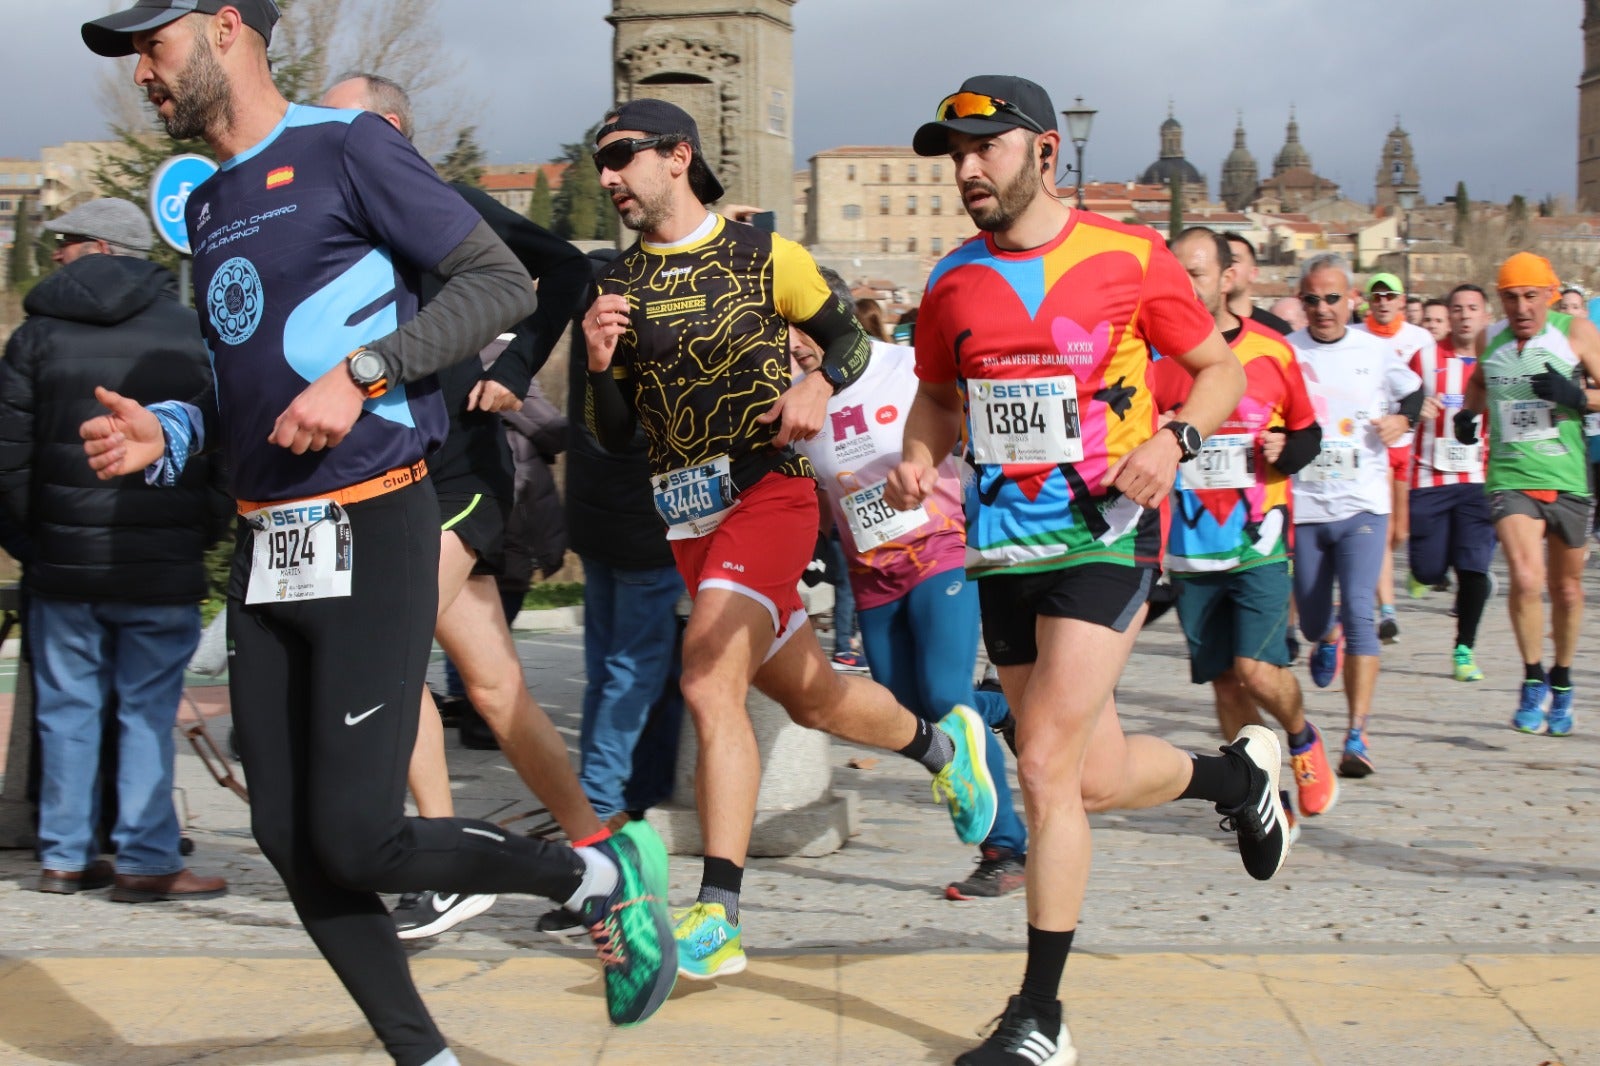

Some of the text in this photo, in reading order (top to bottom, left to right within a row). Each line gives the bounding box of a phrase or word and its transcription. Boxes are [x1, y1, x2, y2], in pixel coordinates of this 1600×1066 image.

[249, 204, 297, 224] CHARRO
[205, 225, 260, 255] SALAMANCA
[660, 298, 706, 313] RUNNERS
[1066, 341, 1094, 353] XXXIX
[1000, 353, 1041, 366] SILVESTRE
[1041, 354, 1093, 365] SALMANTINA
[992, 382, 1065, 399] SETEL
[985, 401, 1047, 435] 1384
[382, 472, 410, 489] Club
[663, 479, 714, 520] 3446
[854, 482, 888, 504] SET
[268, 527, 316, 570] 1924
